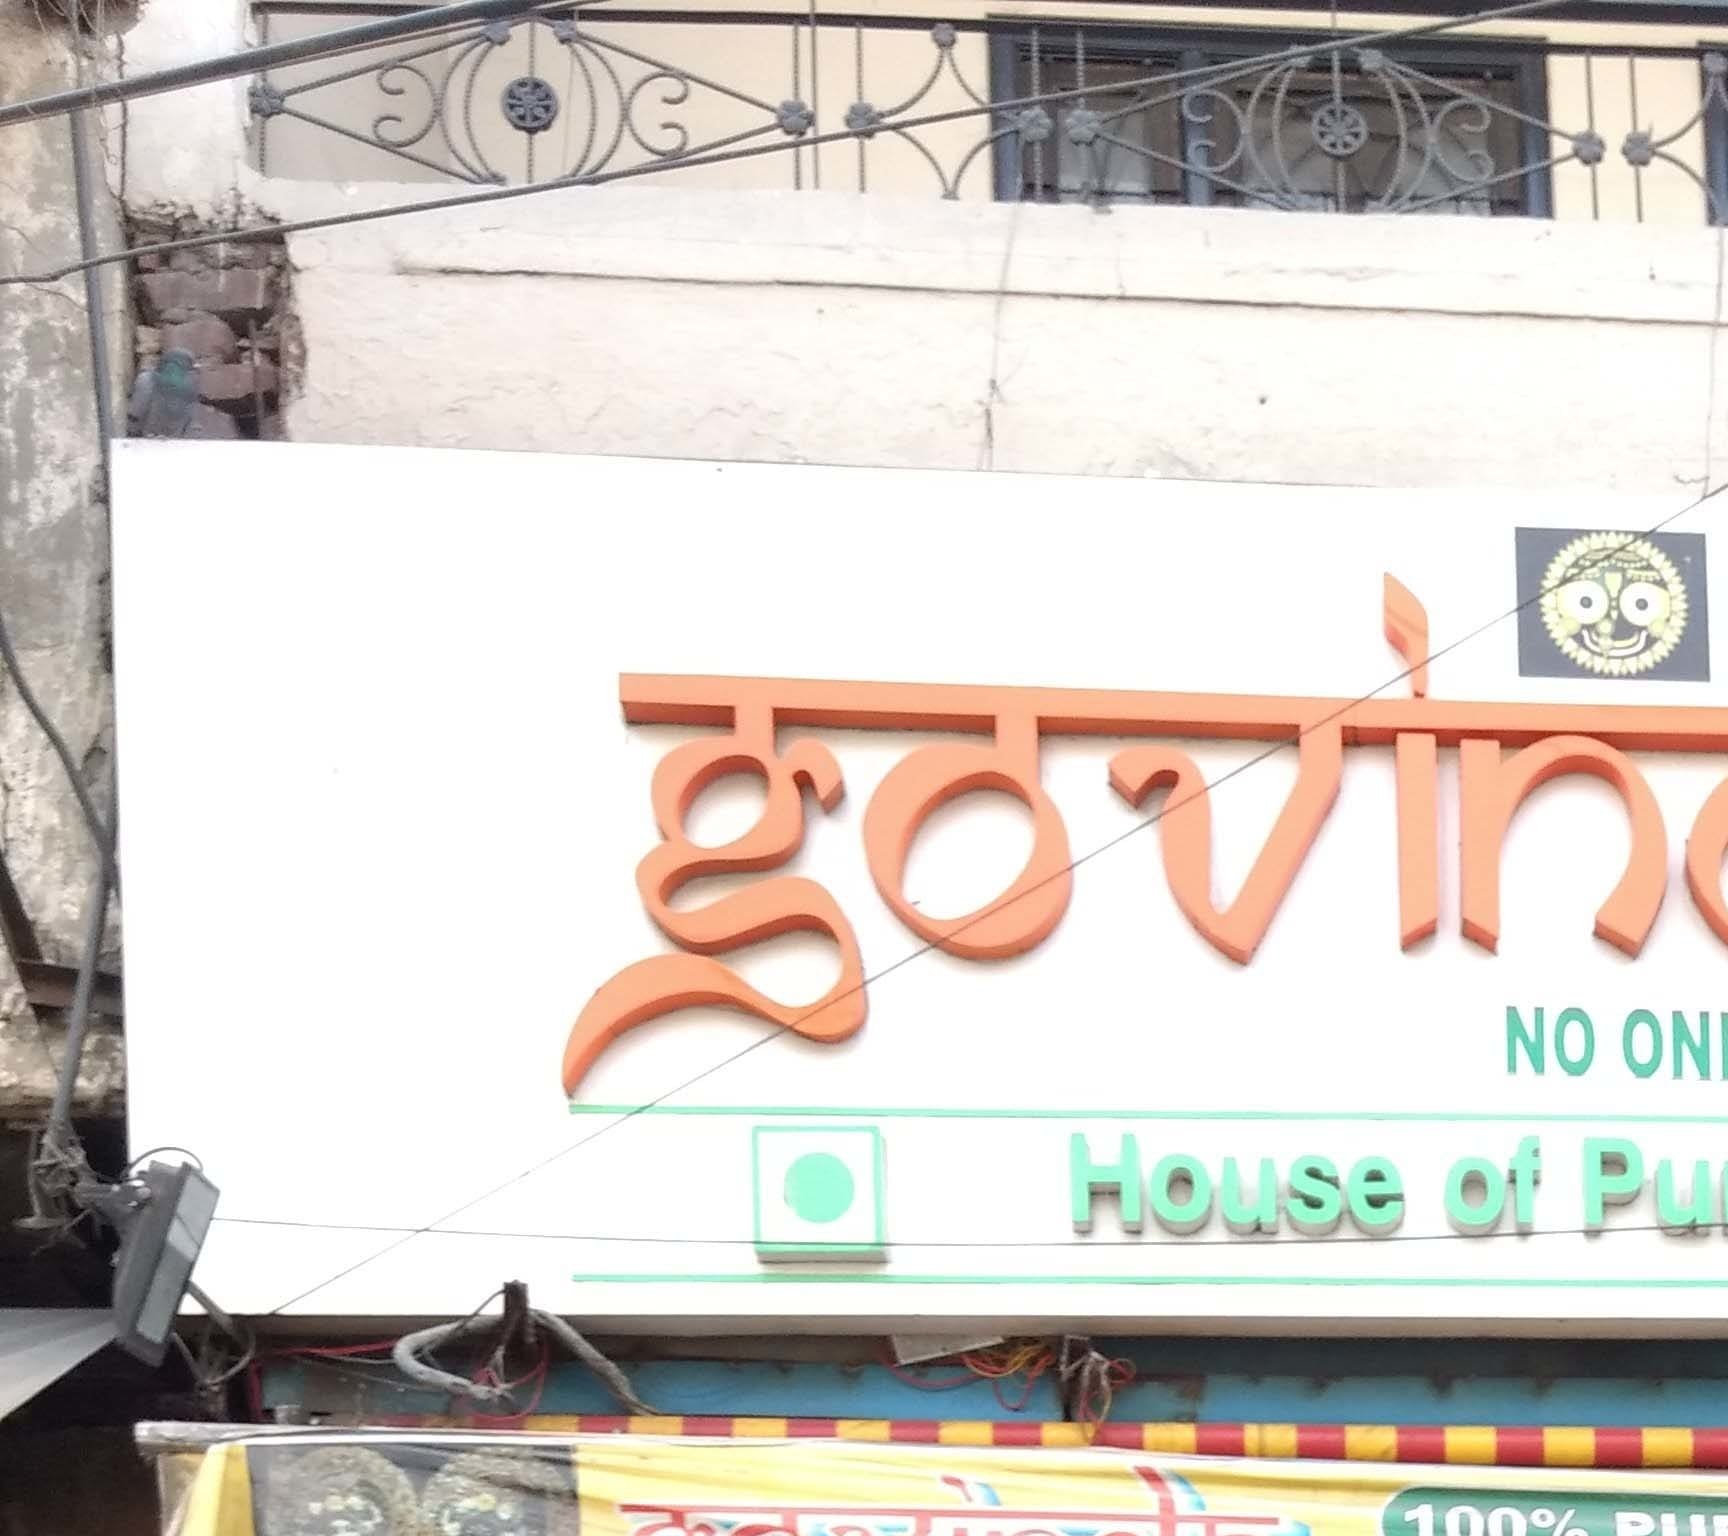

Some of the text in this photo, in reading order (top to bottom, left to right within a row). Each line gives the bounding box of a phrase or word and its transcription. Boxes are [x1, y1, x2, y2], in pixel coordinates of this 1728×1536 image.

[1505, 1006, 1594, 1075] NO
[1068, 1133, 1404, 1236] House
[1444, 1136, 1541, 1236] of
